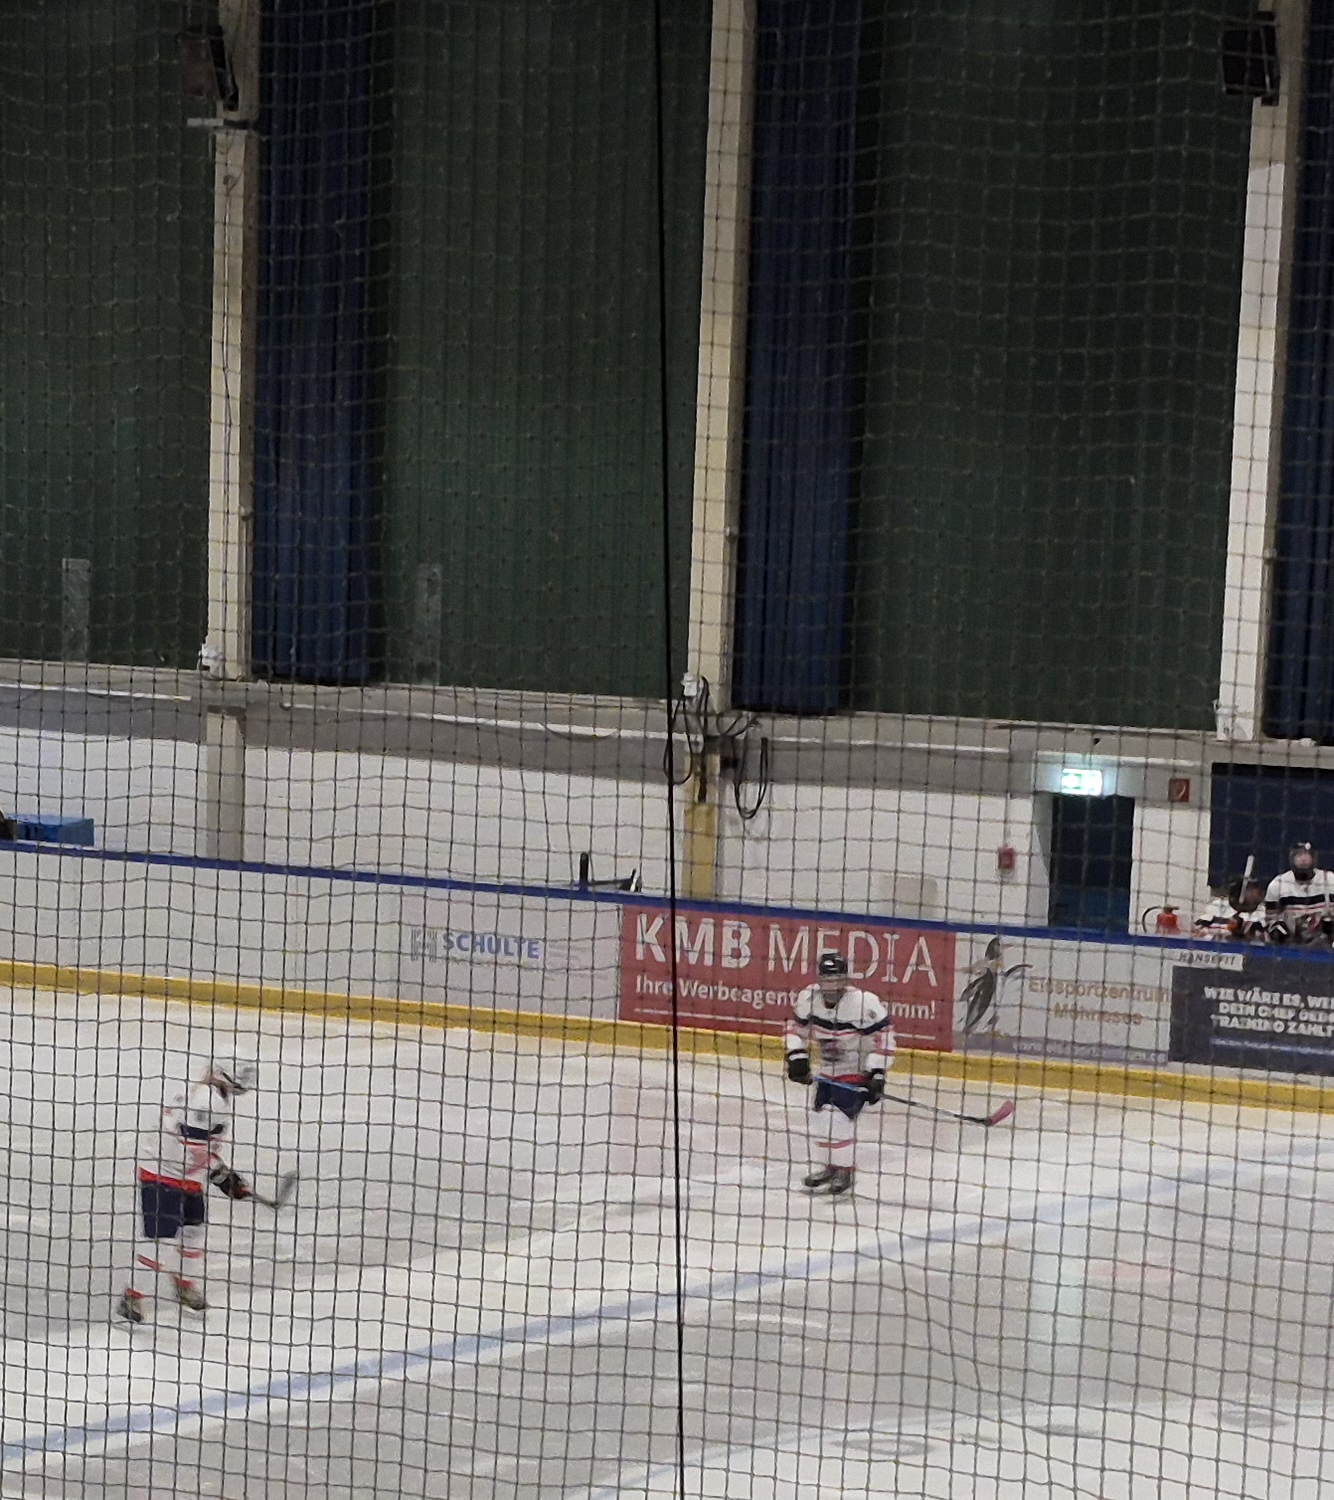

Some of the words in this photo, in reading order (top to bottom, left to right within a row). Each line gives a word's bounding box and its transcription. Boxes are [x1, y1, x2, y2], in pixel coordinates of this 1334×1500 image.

[442, 932, 540, 960] SCHULTE
[635, 912, 752, 969] KMB
[768, 923, 938, 987] MEDIA
